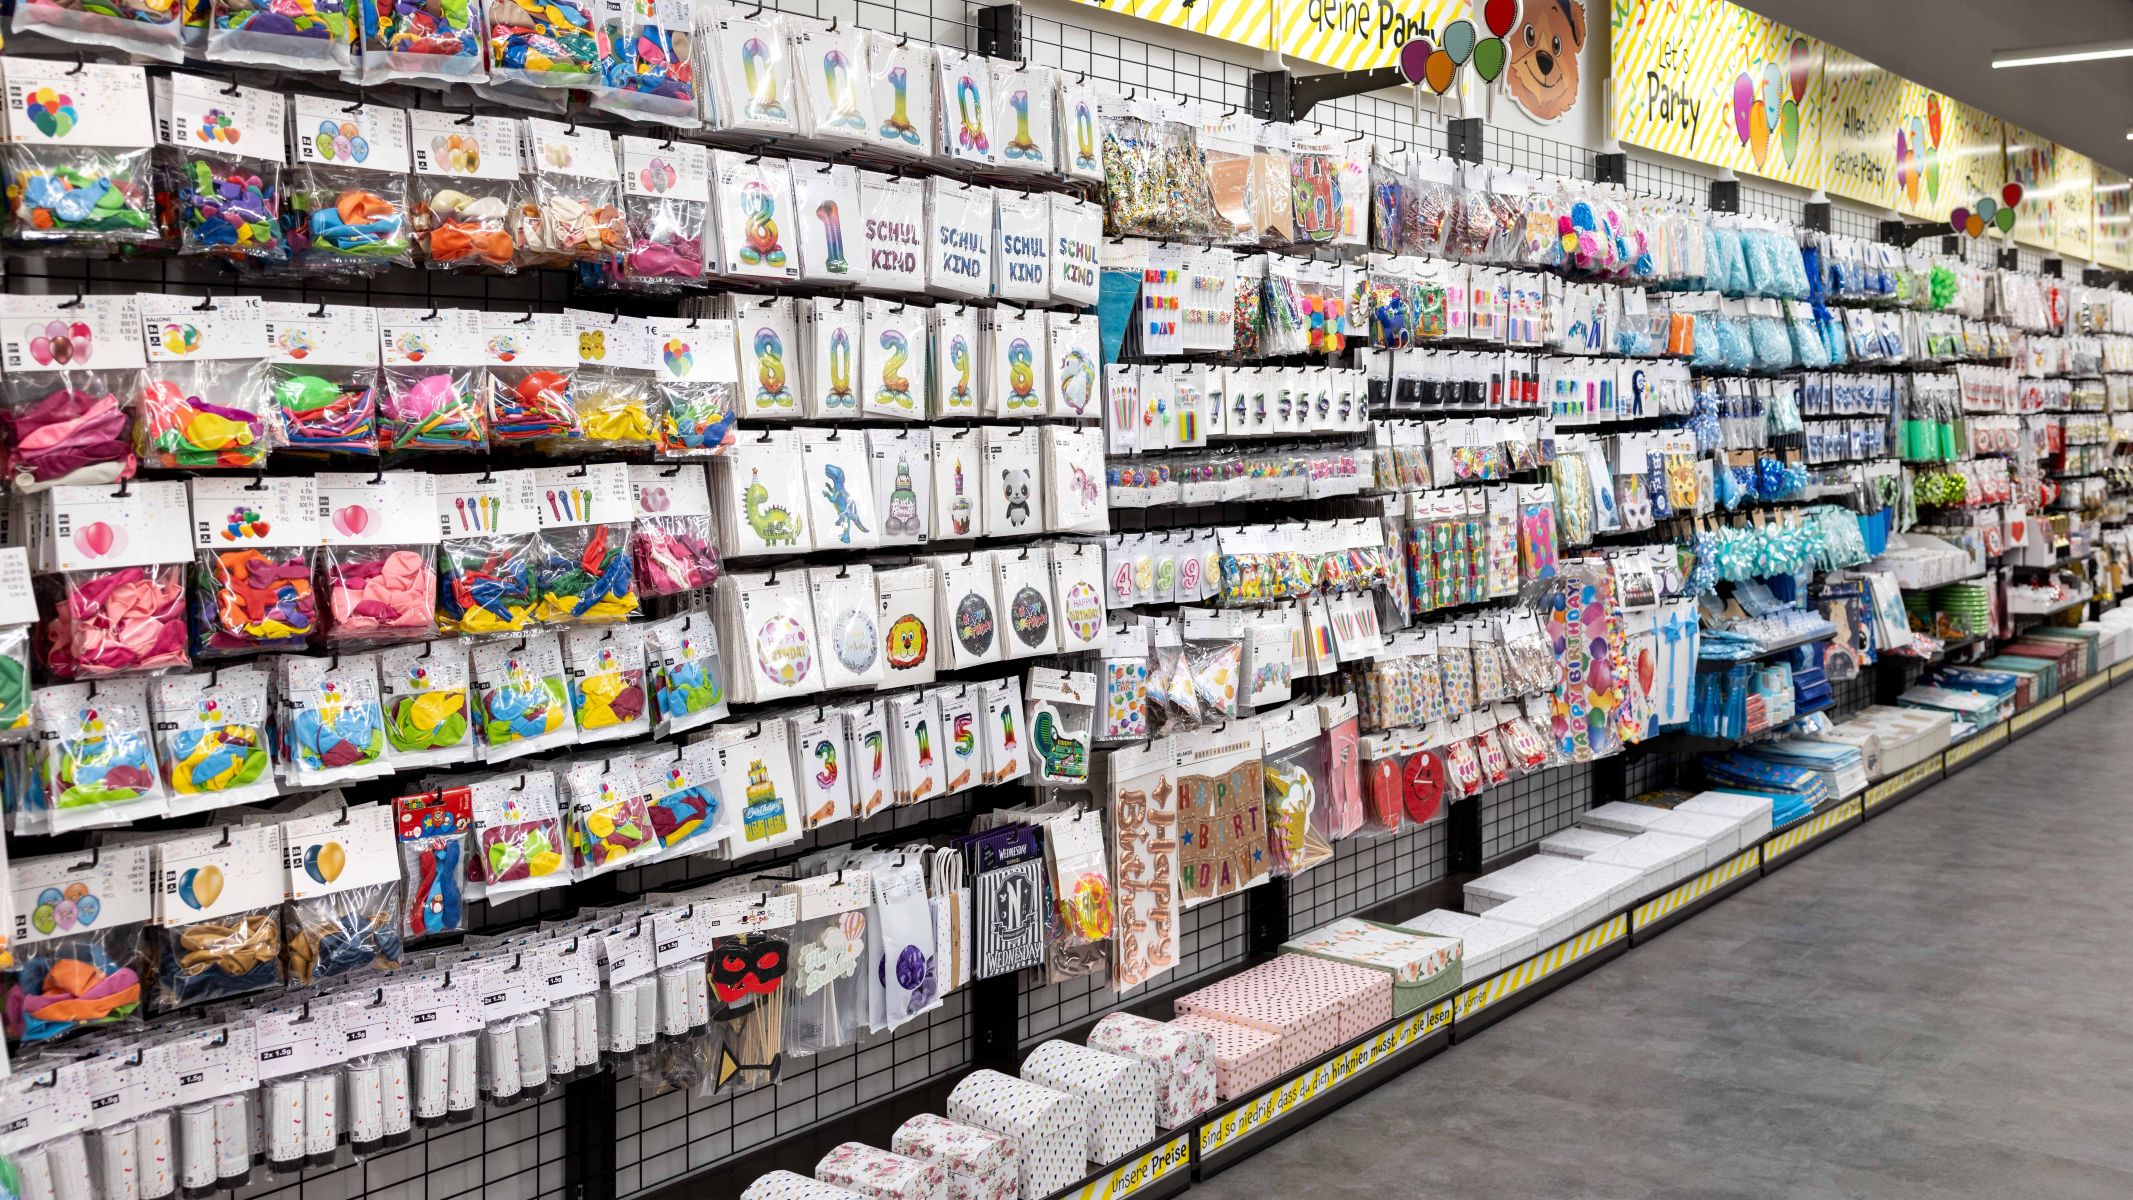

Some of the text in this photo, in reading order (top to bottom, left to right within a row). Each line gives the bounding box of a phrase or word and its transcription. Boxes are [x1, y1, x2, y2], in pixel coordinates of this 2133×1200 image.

[1647, 71, 1701, 150] Party
[1843, 106, 1867, 142] Alles
[1834, 152, 1887, 198] deine Party
[865, 218, 920, 246] SCHUL
[940, 225, 987, 254] SCHUL
[1004, 234, 1047, 258] SCHUL
[871, 248, 916, 273] KIND
[943, 252, 981, 279] KIND
[1059, 237, 1099, 265] SCHUL
[1009, 262, 1043, 284] KIND
[1063, 262, 1094, 287] KIND
[1150, 321, 1176, 335] DAY
[754, 327, 786, 394] 8
[829, 327, 850, 393] 0
[879, 329, 909, 392] 2
[950, 334, 970, 396] 9
[1008, 337, 1034, 396] 8
[1113, 562, 1132, 595] 4
[1157, 559, 1176, 590] 9
[1183, 558, 1200, 589] 9
[1566, 577, 1582, 683] BIRTHDAY!
[954, 712, 975, 756] 5
[1000, 704, 1016, 751] 1
[864, 730, 882, 781] 7
[914, 720, 933, 768] 1
[815, 740, 838, 789] 3
[1179, 768, 1258, 810] HAPPY
[746, 801, 780, 819] Birthday
[1199, 806, 1258, 849] BIRT
[998, 844, 1027, 861] WEDNESDAY
[1183, 852, 1252, 889] HDAY
[1007, 878, 1023, 931] N
[986, 941, 1043, 973] WEDNESDAY
[493, 995, 506, 1003] 1.5g
[1464, 991, 1487, 1014] können
[423, 1013, 436, 1022] 1.5g
[352, 1031, 366, 1040] 1.5g
[263, 1047, 292, 1060] 2x 1.5g
[186, 1073, 203, 1084] 1.5g
[1202, 1122, 1222, 1149] sind
[1225, 1122, 1236, 1137] so
[1239, 1098, 1275, 1128] niedrig,
[1277, 1087, 1298, 1110] dass
[1300, 1079, 1310, 1097] du
[1312, 1067, 1330, 1090] dich
[1331, 1051, 1368, 1080] hinknien
[1370, 1032, 1398, 1058] musst,
[1413, 1017, 1424, 1034] sie
[1426, 1009, 1450, 1028] lesen
[100, 1095, 119, 1107] 1.5g
[1112, 1142, 1188, 1193] Unsere Preise
